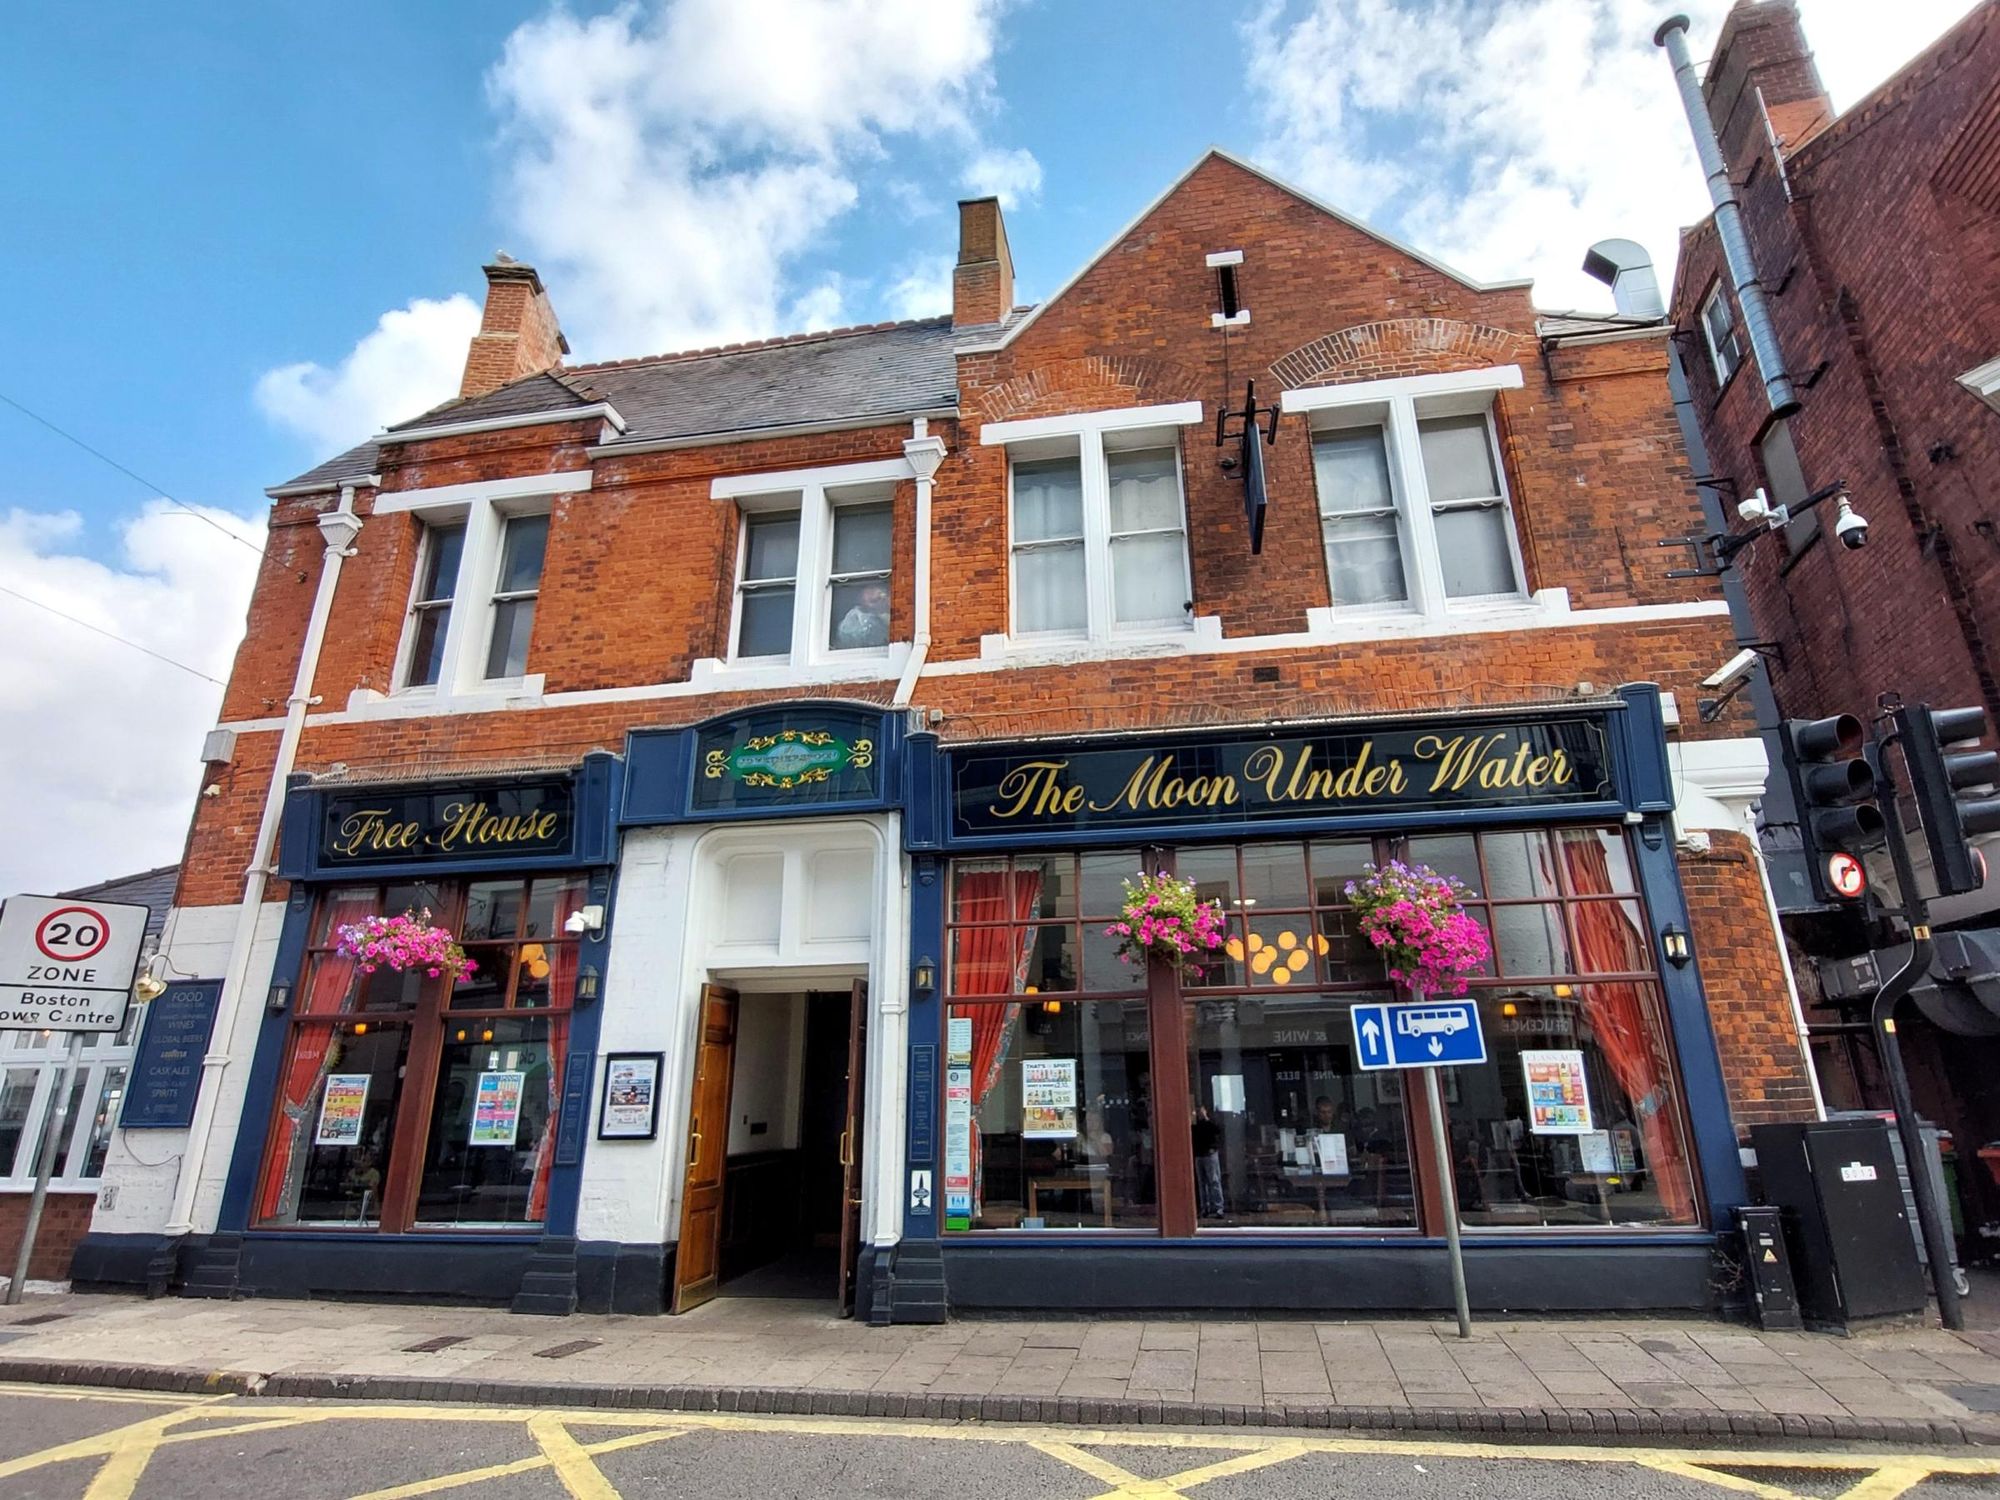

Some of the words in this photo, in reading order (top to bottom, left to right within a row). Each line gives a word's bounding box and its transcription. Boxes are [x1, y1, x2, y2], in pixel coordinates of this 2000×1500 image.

[989, 761, 1085, 818] The
[1089, 754, 1239, 811] Moon
[1244, 741, 1408, 801] Under
[1414, 732, 1573, 792] Water
[333, 808, 418, 855] Free
[426, 801, 558, 850] House
[47, 922, 100, 948] 20
[27, 965, 97, 982] ZONE
[21, 992, 91, 1007] Boston
[172, 991, 203, 1002] FOOD
[48, 1009, 115, 1024] Cntre
